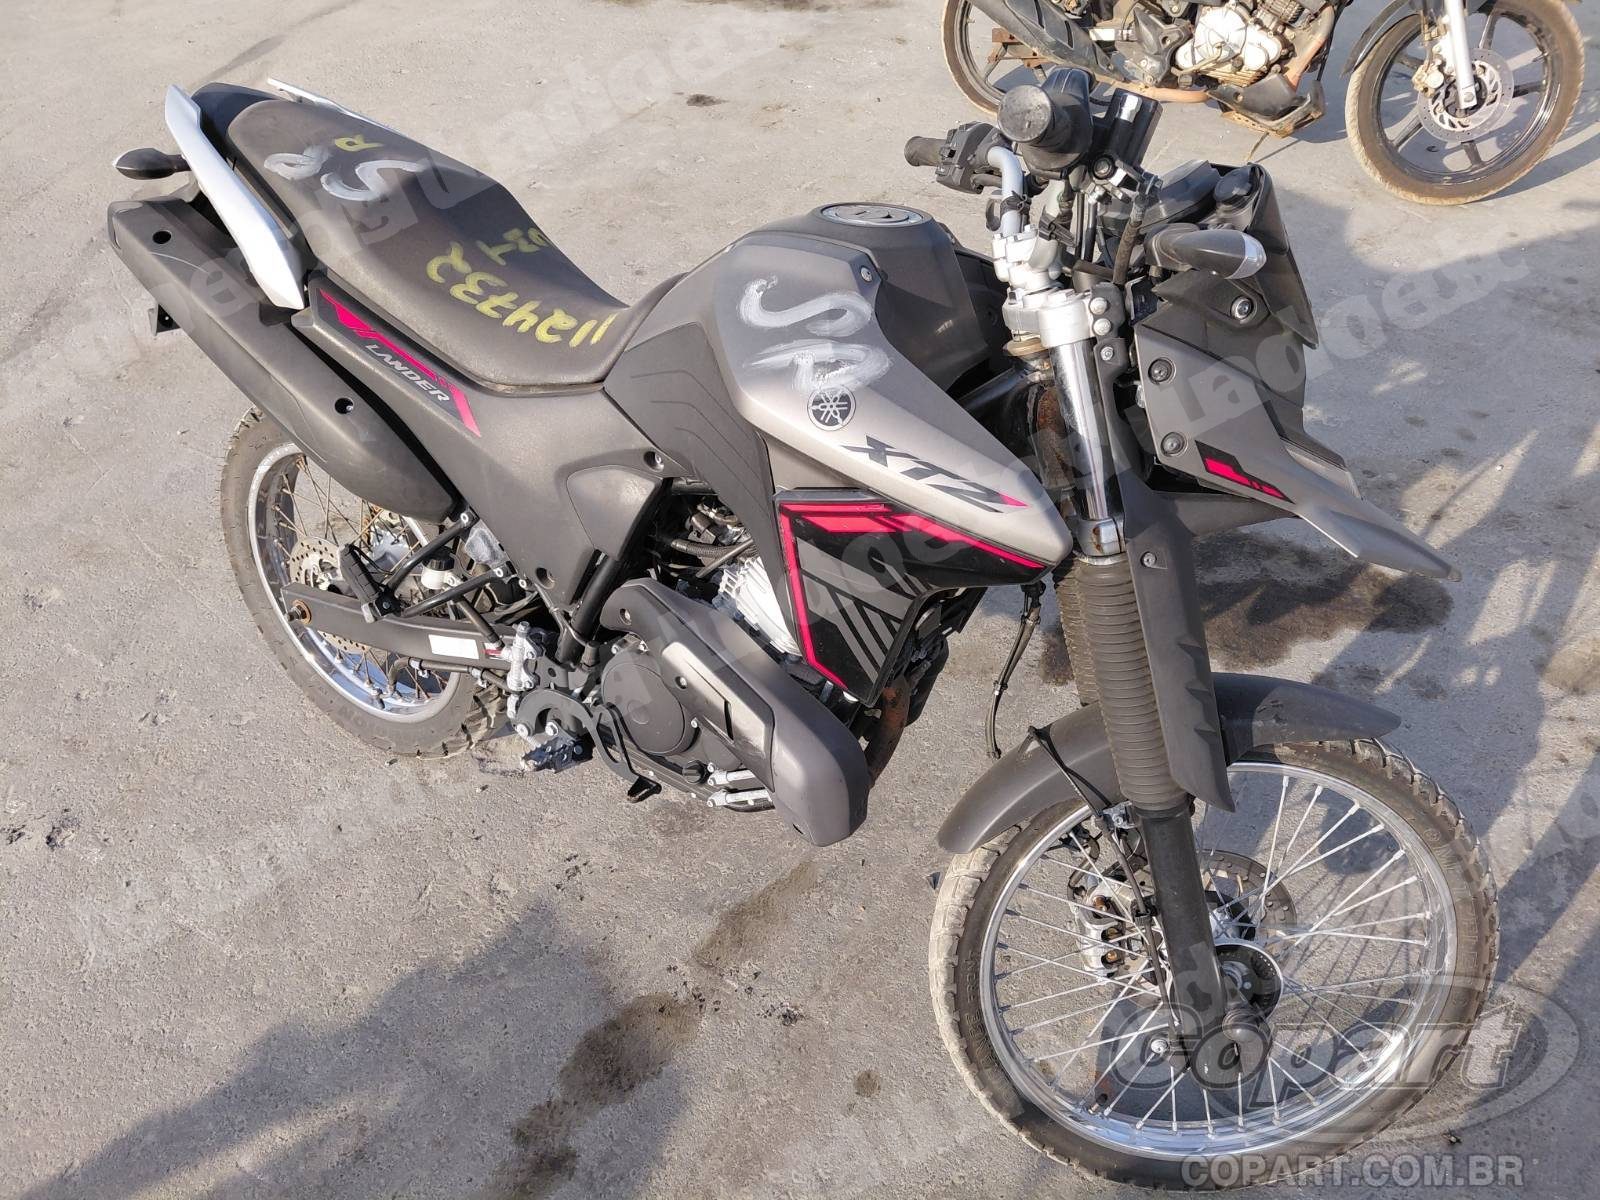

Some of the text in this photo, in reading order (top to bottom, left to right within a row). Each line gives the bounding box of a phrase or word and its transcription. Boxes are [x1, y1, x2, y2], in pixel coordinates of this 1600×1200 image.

[425, 240, 618, 348] 1124732
[365, 343, 450, 402] LANDER
[839, 435, 1028, 513] XTZ
